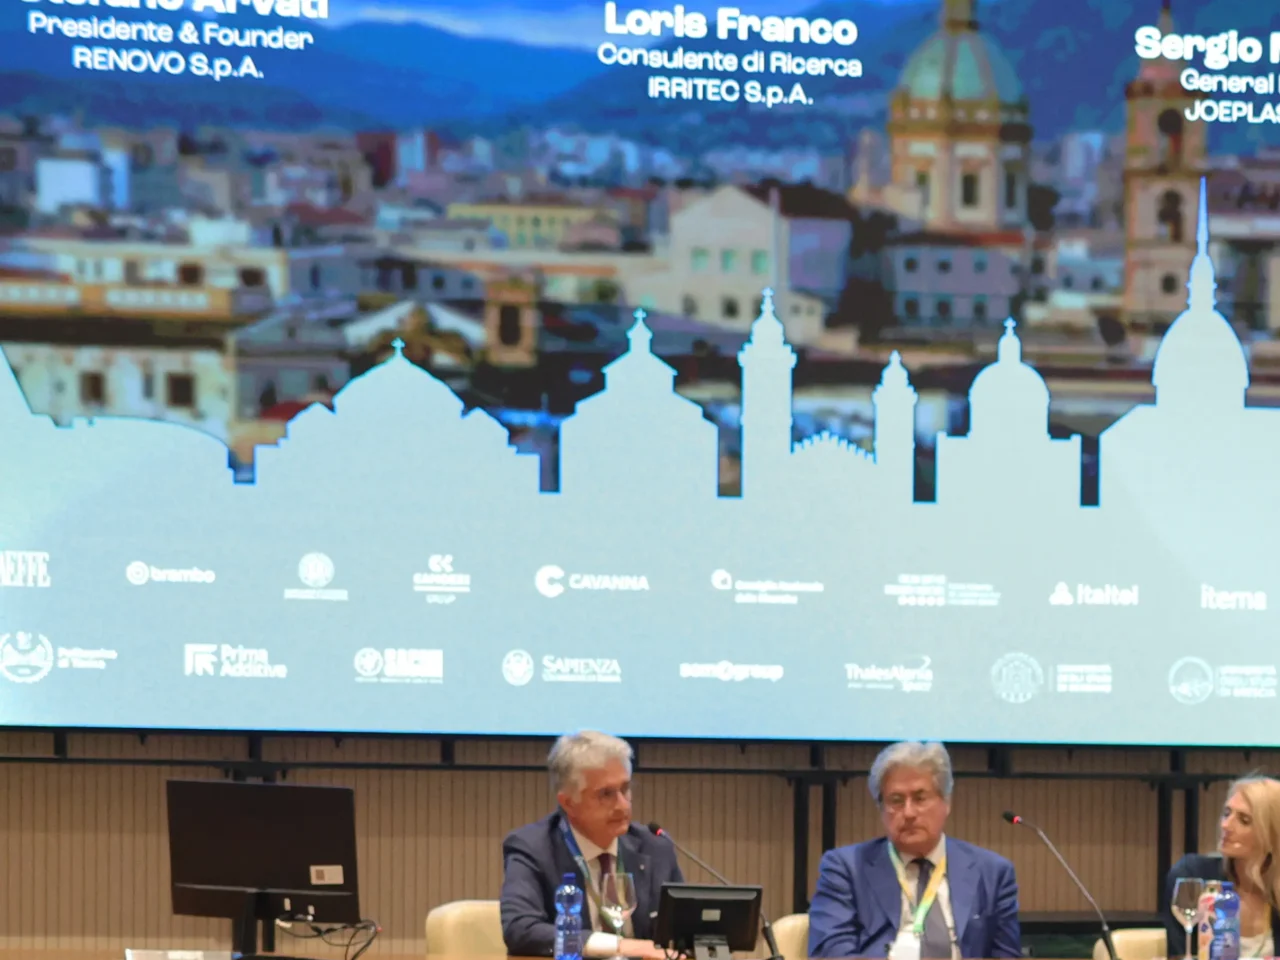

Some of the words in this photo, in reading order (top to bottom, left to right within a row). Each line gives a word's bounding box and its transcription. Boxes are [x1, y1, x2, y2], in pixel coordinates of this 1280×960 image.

[28, 10, 173, 43] Presidente
[178, 20, 199, 44] &
[203, 22, 314, 50] Founder
[604, 1, 708, 39] Loris
[716, 7, 858, 46] Franco
[72, 45, 186, 75] RENOVO
[189, 52, 264, 81] S.p.A.
[597, 41, 738, 72] Consulente
[742, 51, 765, 73] di
[769, 51, 862, 77] Ricerca
[1134, 25, 1263, 70] Sergio
[648, 76, 740, 102] IRRITEC
[744, 80, 814, 108] S.p.A.
[1180, 67, 1275, 94] General
[569, 573, 650, 591] CAVANNA
[219, 644, 269, 663] Prima
[218, 663, 288, 679] Additive
